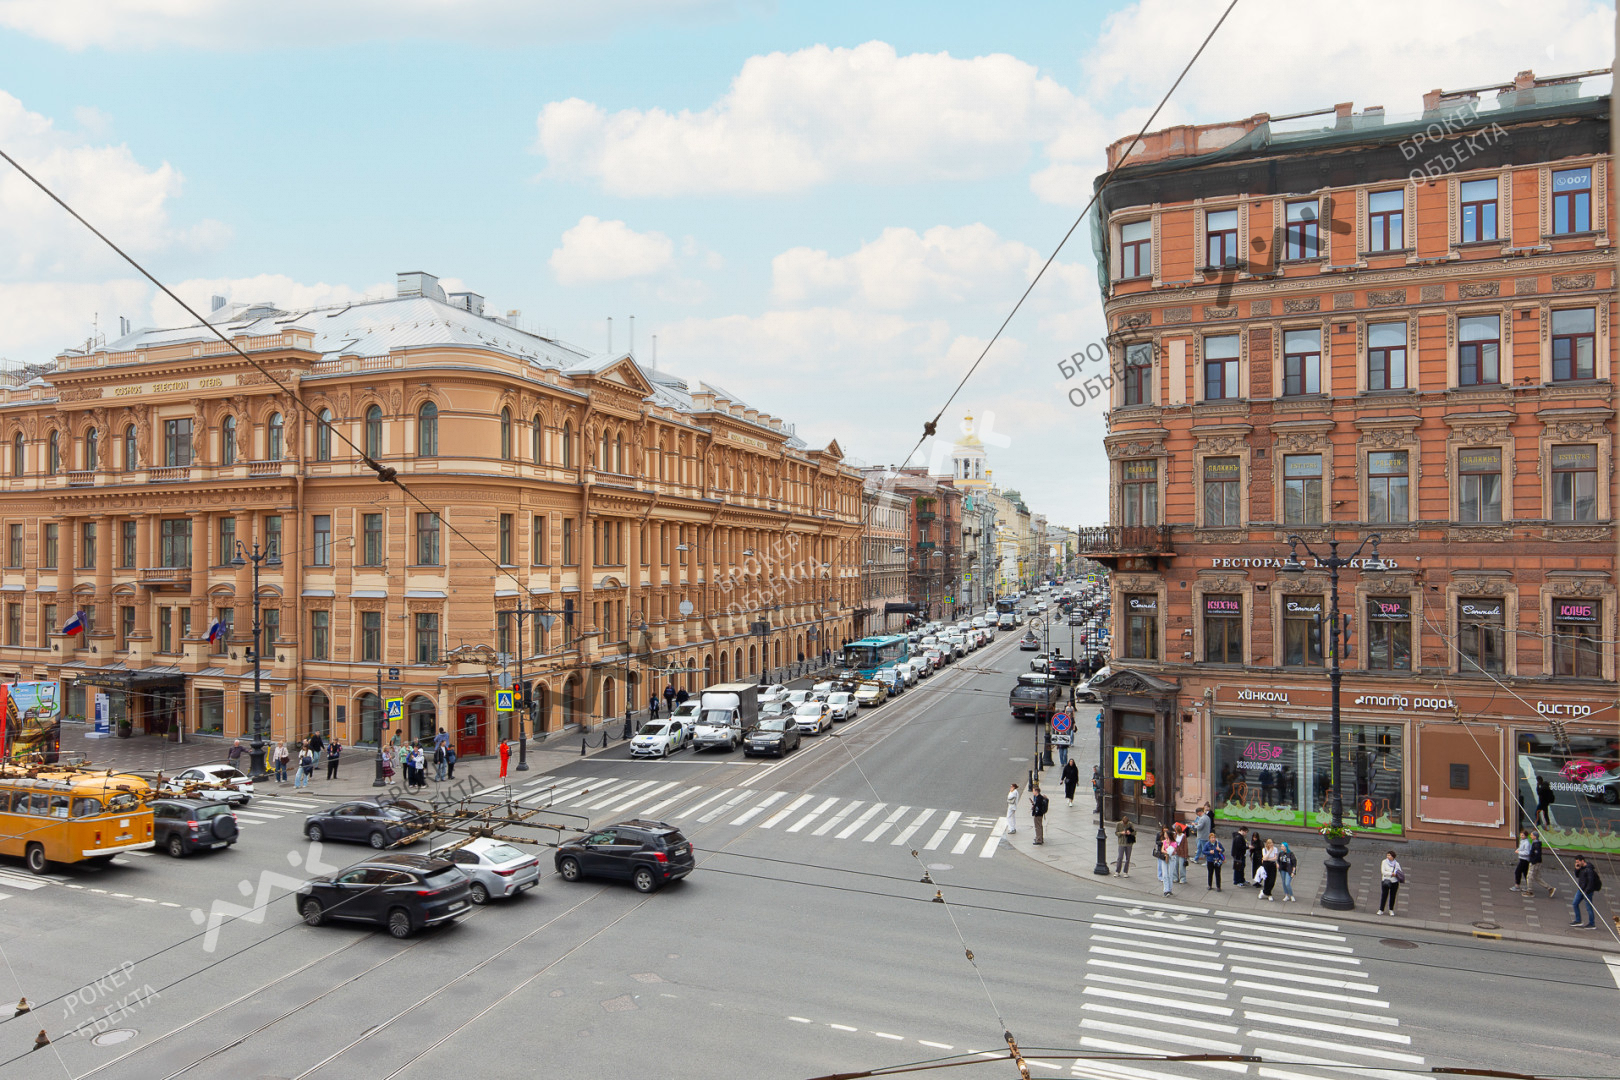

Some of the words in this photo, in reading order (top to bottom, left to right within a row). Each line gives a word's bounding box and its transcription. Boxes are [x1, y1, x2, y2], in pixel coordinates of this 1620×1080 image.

[1567, 175, 1587, 185] 007
[114, 386, 142, 396] COSMOS
[152, 381, 189, 392] SELECTION
[199, 378, 223, 388] ОТЕЛЬ
[1207, 600, 1239, 609] КУХНЯ
[1381, 603, 1400, 613] БАР
[1462, 604, 1501, 615] Commode
[1560, 605, 1592, 617] КЛУБ
[1237, 690, 1288, 702] хинкали
[1537, 701, 1591, 717] бистро
[1362, 815, 1374, 824] 01
